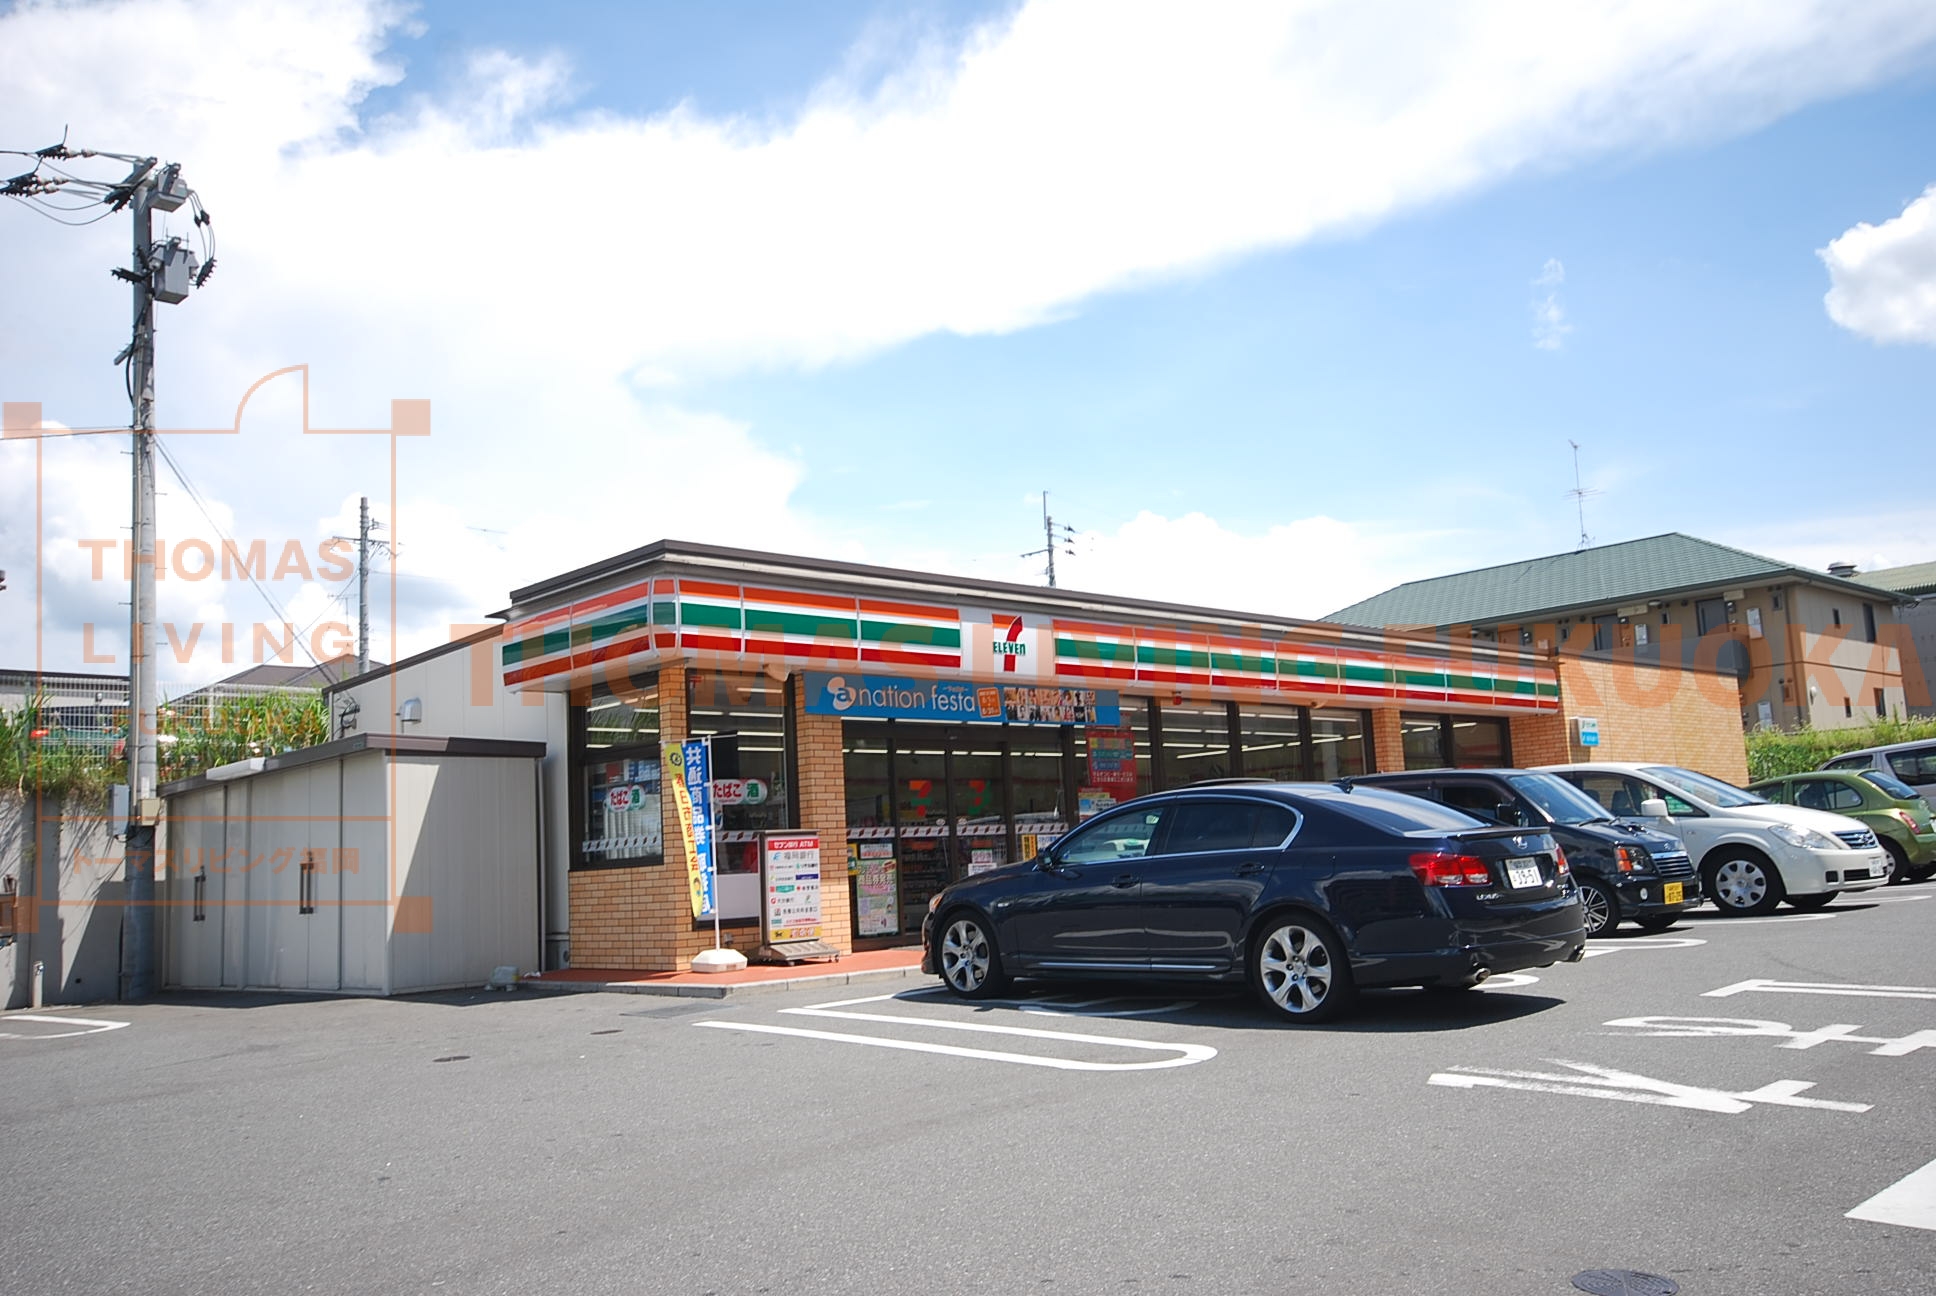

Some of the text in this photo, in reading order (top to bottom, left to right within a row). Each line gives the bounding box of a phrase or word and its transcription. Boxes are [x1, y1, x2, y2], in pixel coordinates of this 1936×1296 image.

[931, 685, 976, 712] festa
[610, 789, 629, 806] たばこ
[713, 783, 742, 798] たばこ
